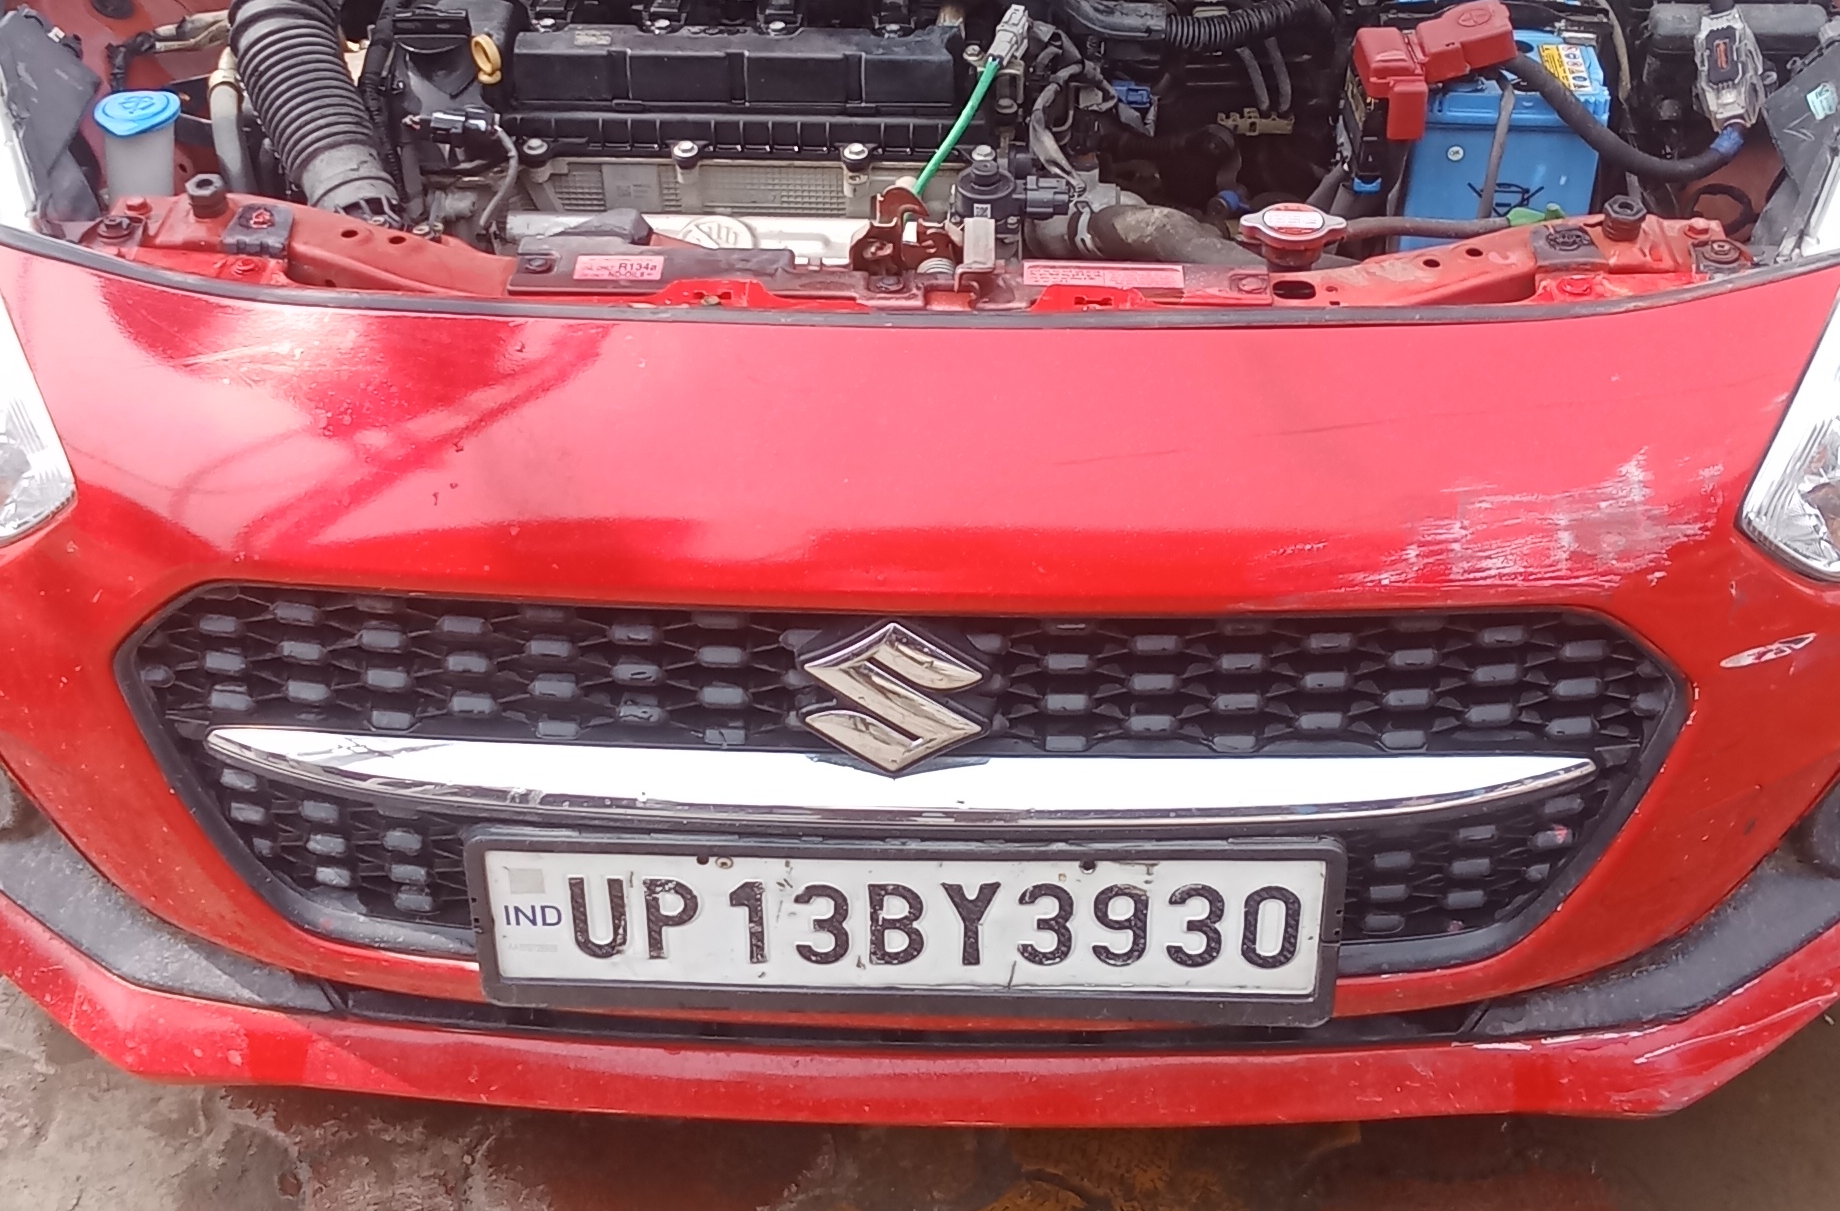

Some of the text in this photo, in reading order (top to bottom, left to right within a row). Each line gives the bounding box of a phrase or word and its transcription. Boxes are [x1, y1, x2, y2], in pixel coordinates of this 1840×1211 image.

[618, 262, 657, 271] R134a
[503, 876, 1304, 970] IND UP13BY3930
